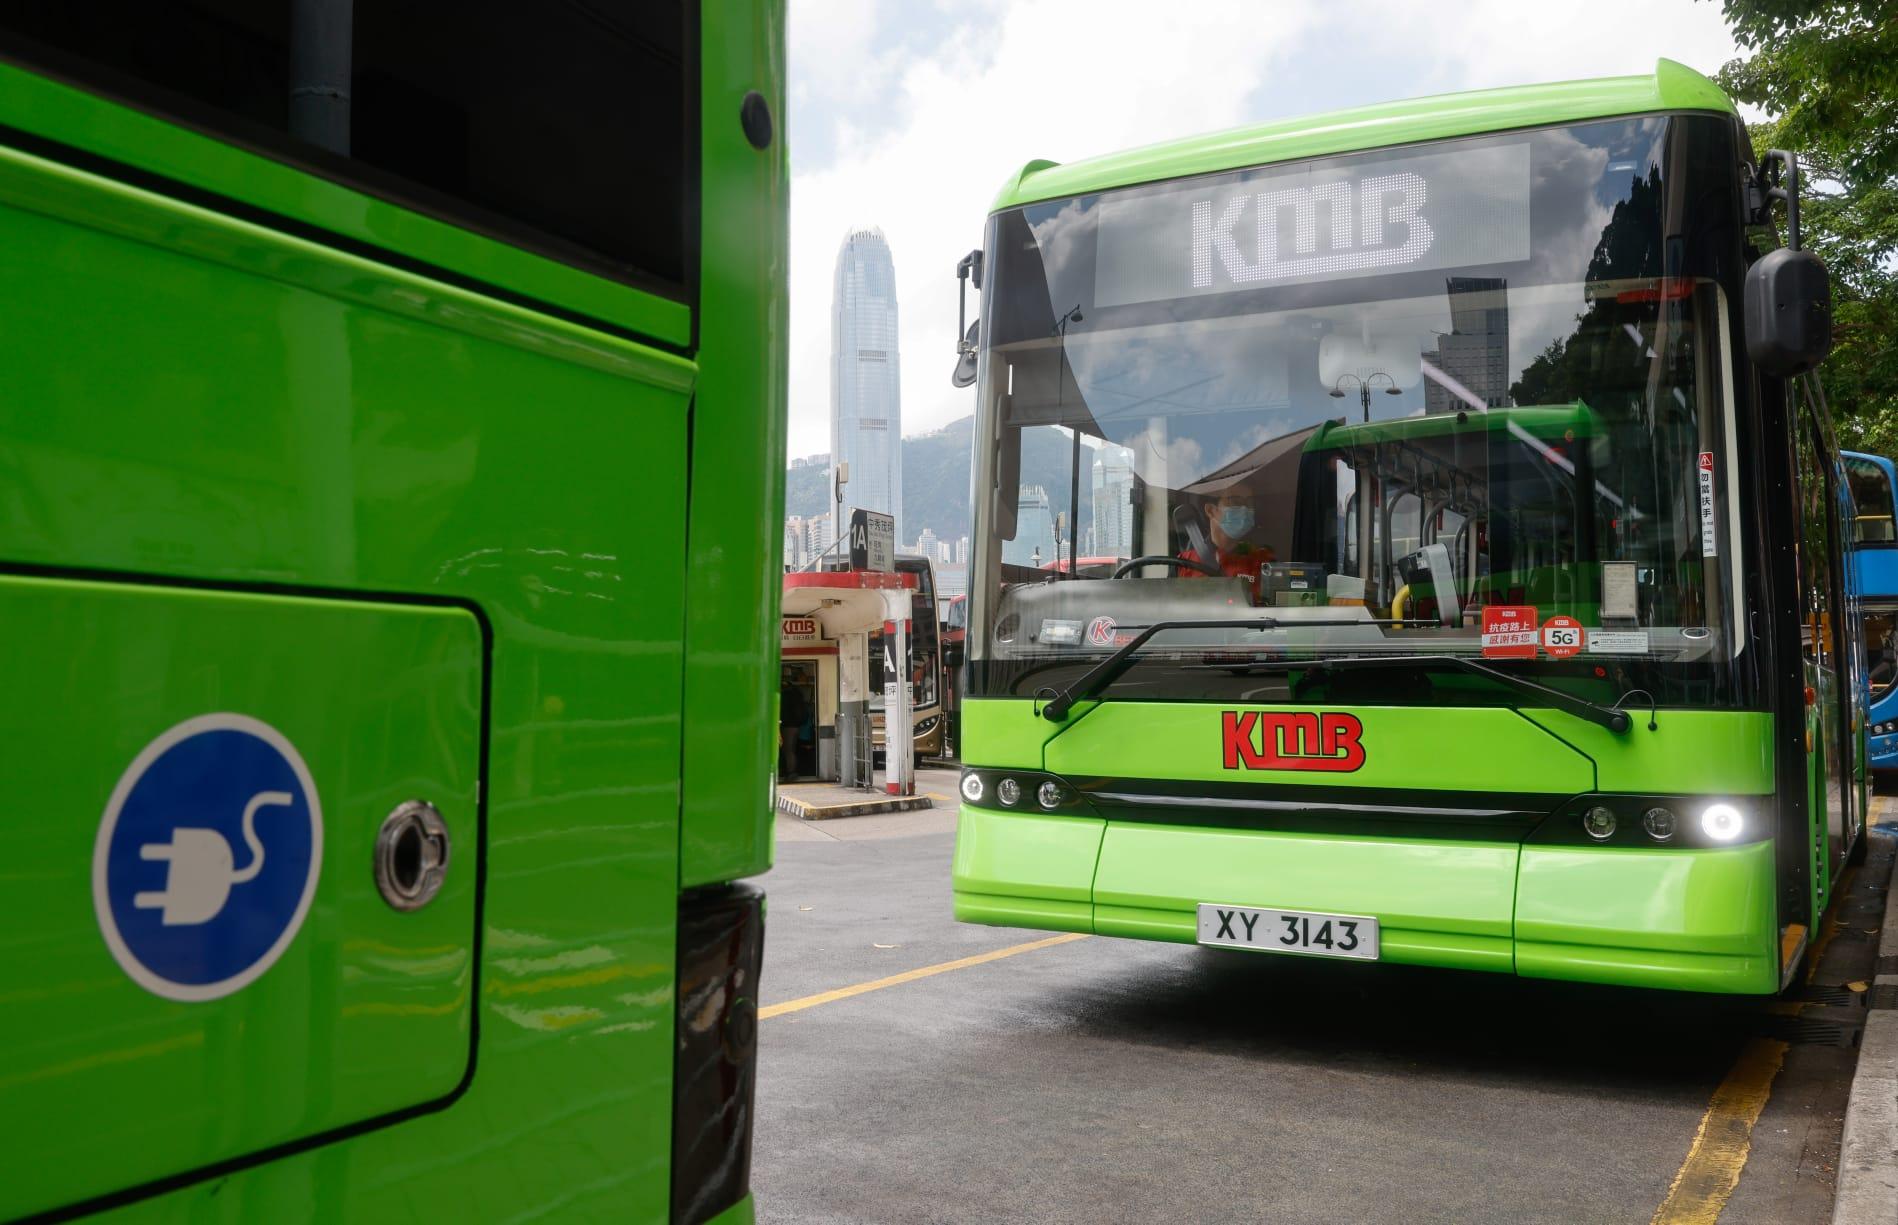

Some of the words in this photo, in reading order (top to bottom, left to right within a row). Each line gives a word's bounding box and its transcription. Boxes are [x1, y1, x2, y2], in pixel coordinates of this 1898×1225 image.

[1192, 172, 1434, 288] KMB
[852, 524, 867, 550] 1A
[1489, 621, 1530, 632] 抗疫路上
[1490, 634, 1530, 645] 感謝有您
[1552, 630, 1573, 645] 5G
[1222, 711, 1366, 773] KMB
[1216, 909, 1259, 941] XY
[1280, 916, 1358, 951] 3143
